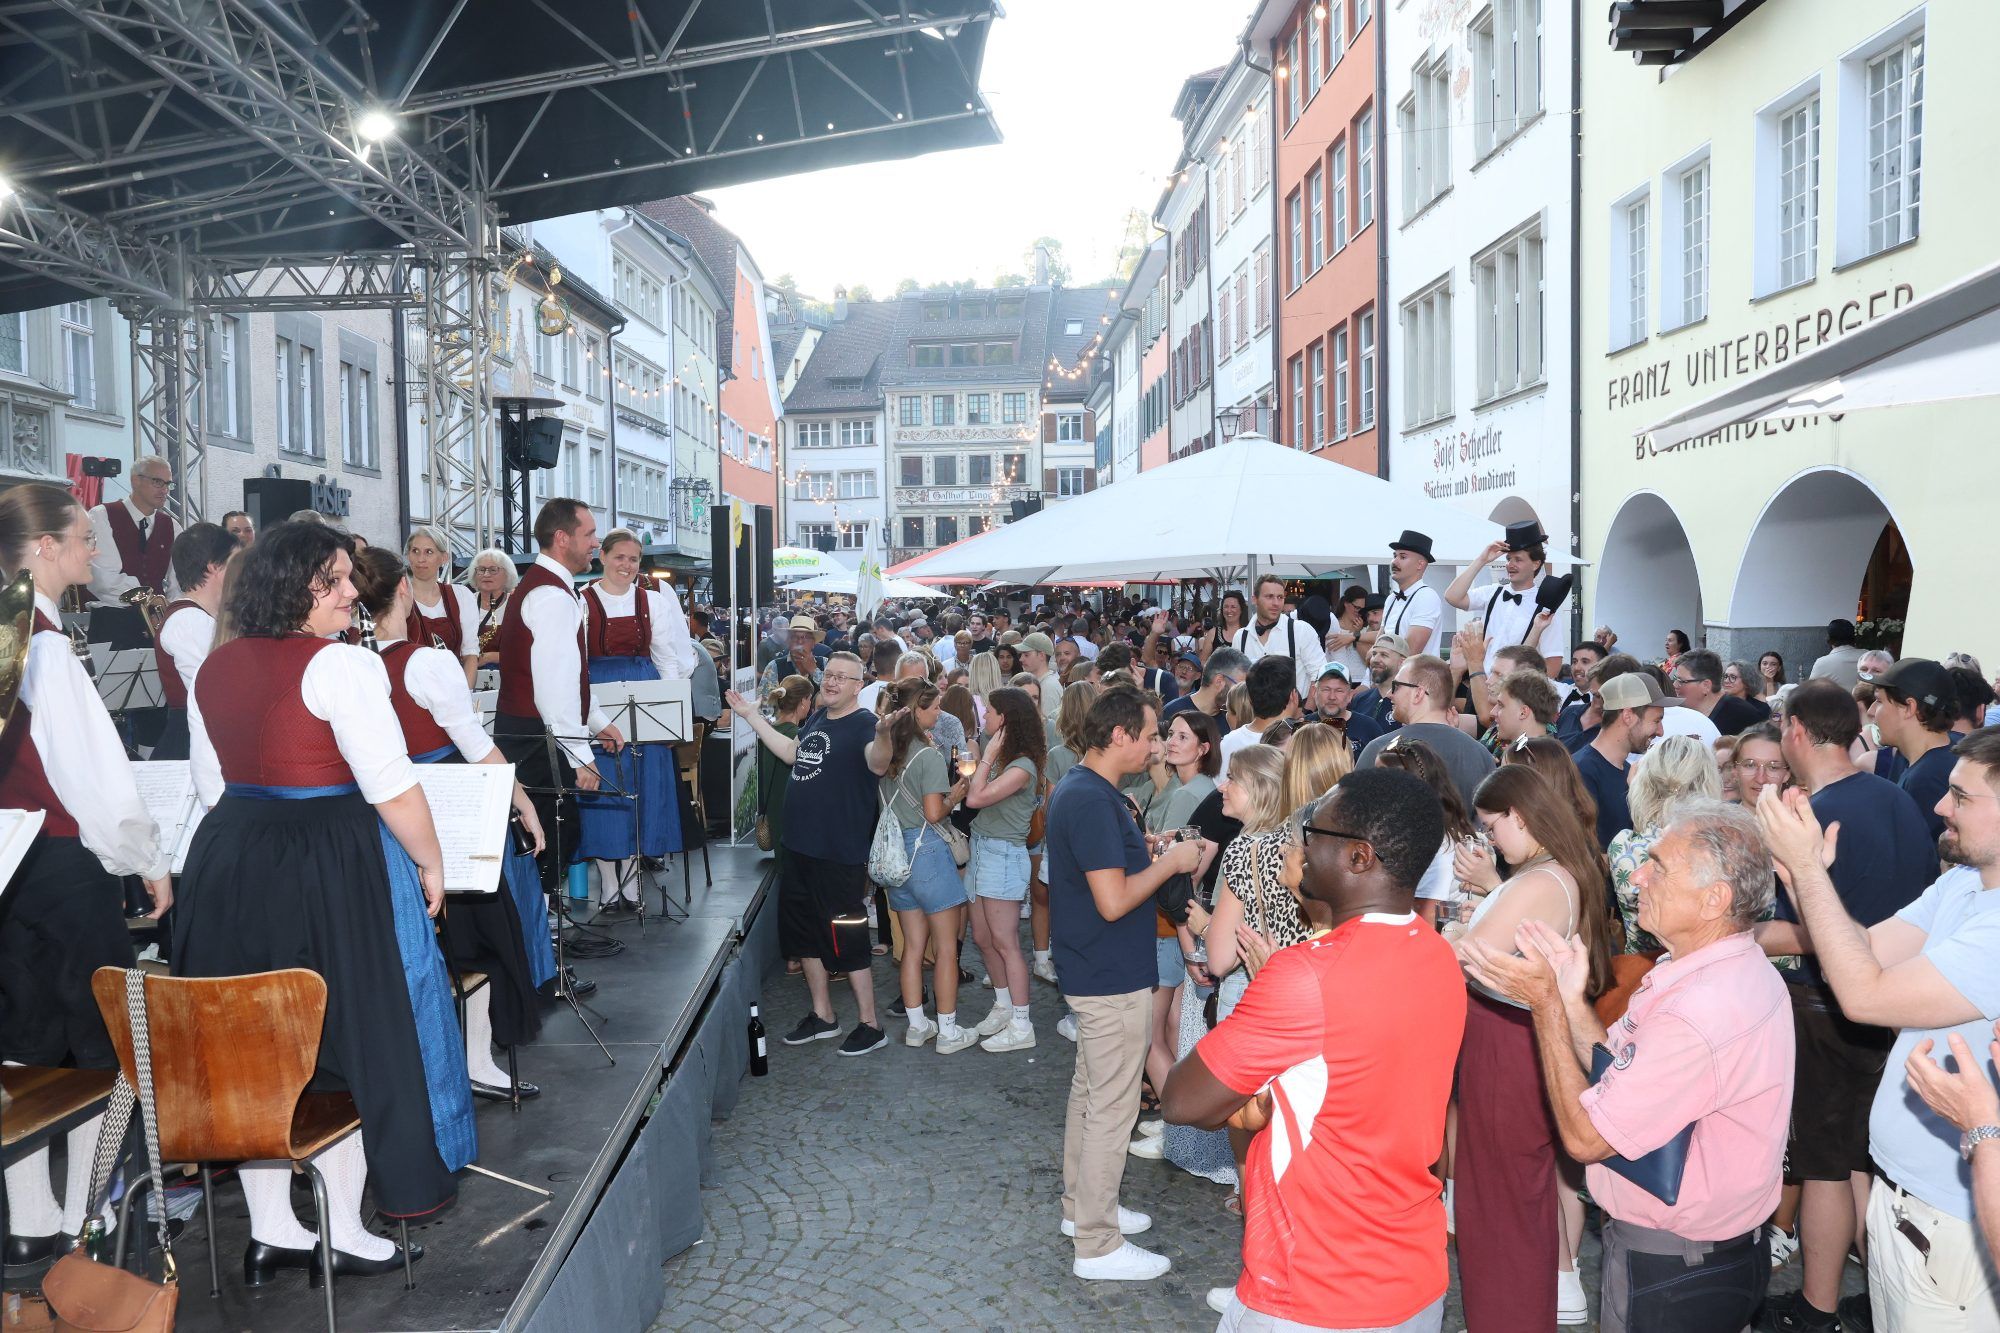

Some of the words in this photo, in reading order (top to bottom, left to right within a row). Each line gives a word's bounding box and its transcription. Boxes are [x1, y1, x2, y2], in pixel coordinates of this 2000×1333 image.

[1608, 360, 1671, 411] FRANZ
[1454, 476, 1469, 496] und
[1471, 464, 1516, 494] Konditorei
